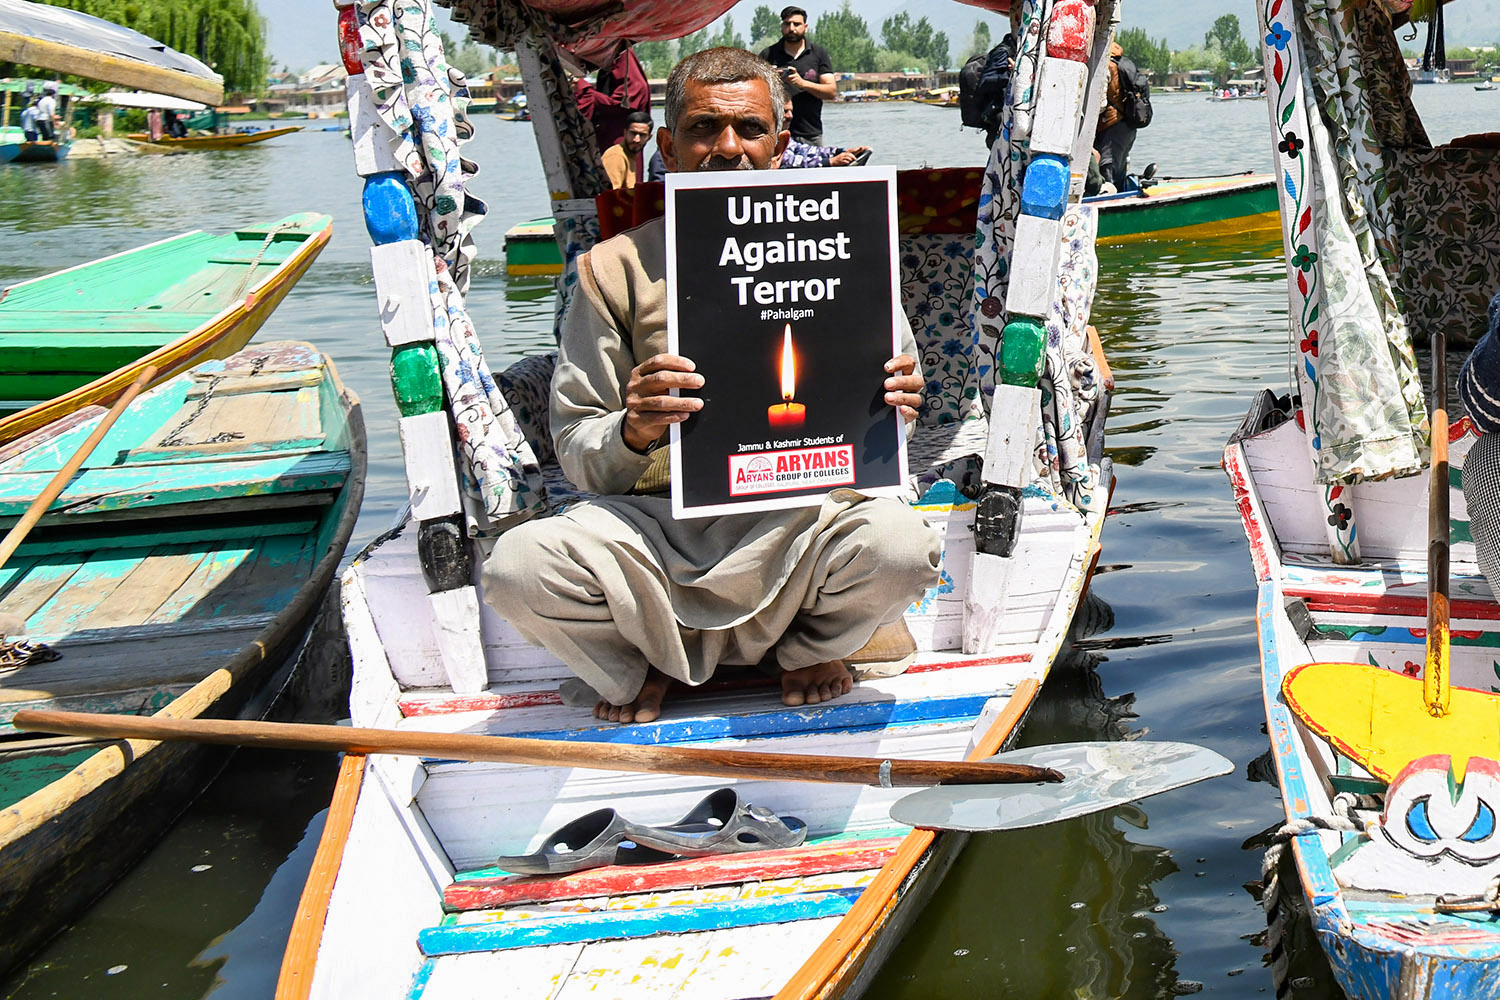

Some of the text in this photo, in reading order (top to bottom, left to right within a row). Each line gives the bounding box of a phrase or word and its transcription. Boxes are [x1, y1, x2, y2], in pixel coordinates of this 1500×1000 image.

[727, 191, 840, 225] United
[718, 232, 851, 272] Against
[730, 276, 840, 306] Terror
[760, 307, 814, 321] #Pahalgam
[738, 442, 763, 452] Jammu
[773, 438, 802, 449] Kashmir
[803, 436, 834, 446] Students
[836, 434, 844, 443] of
[776, 450, 850, 473] ARYANS
[736, 468, 774, 484] ARYANS
[776, 473, 801, 481] GROUP
[814, 467, 849, 477] COLLEGES
